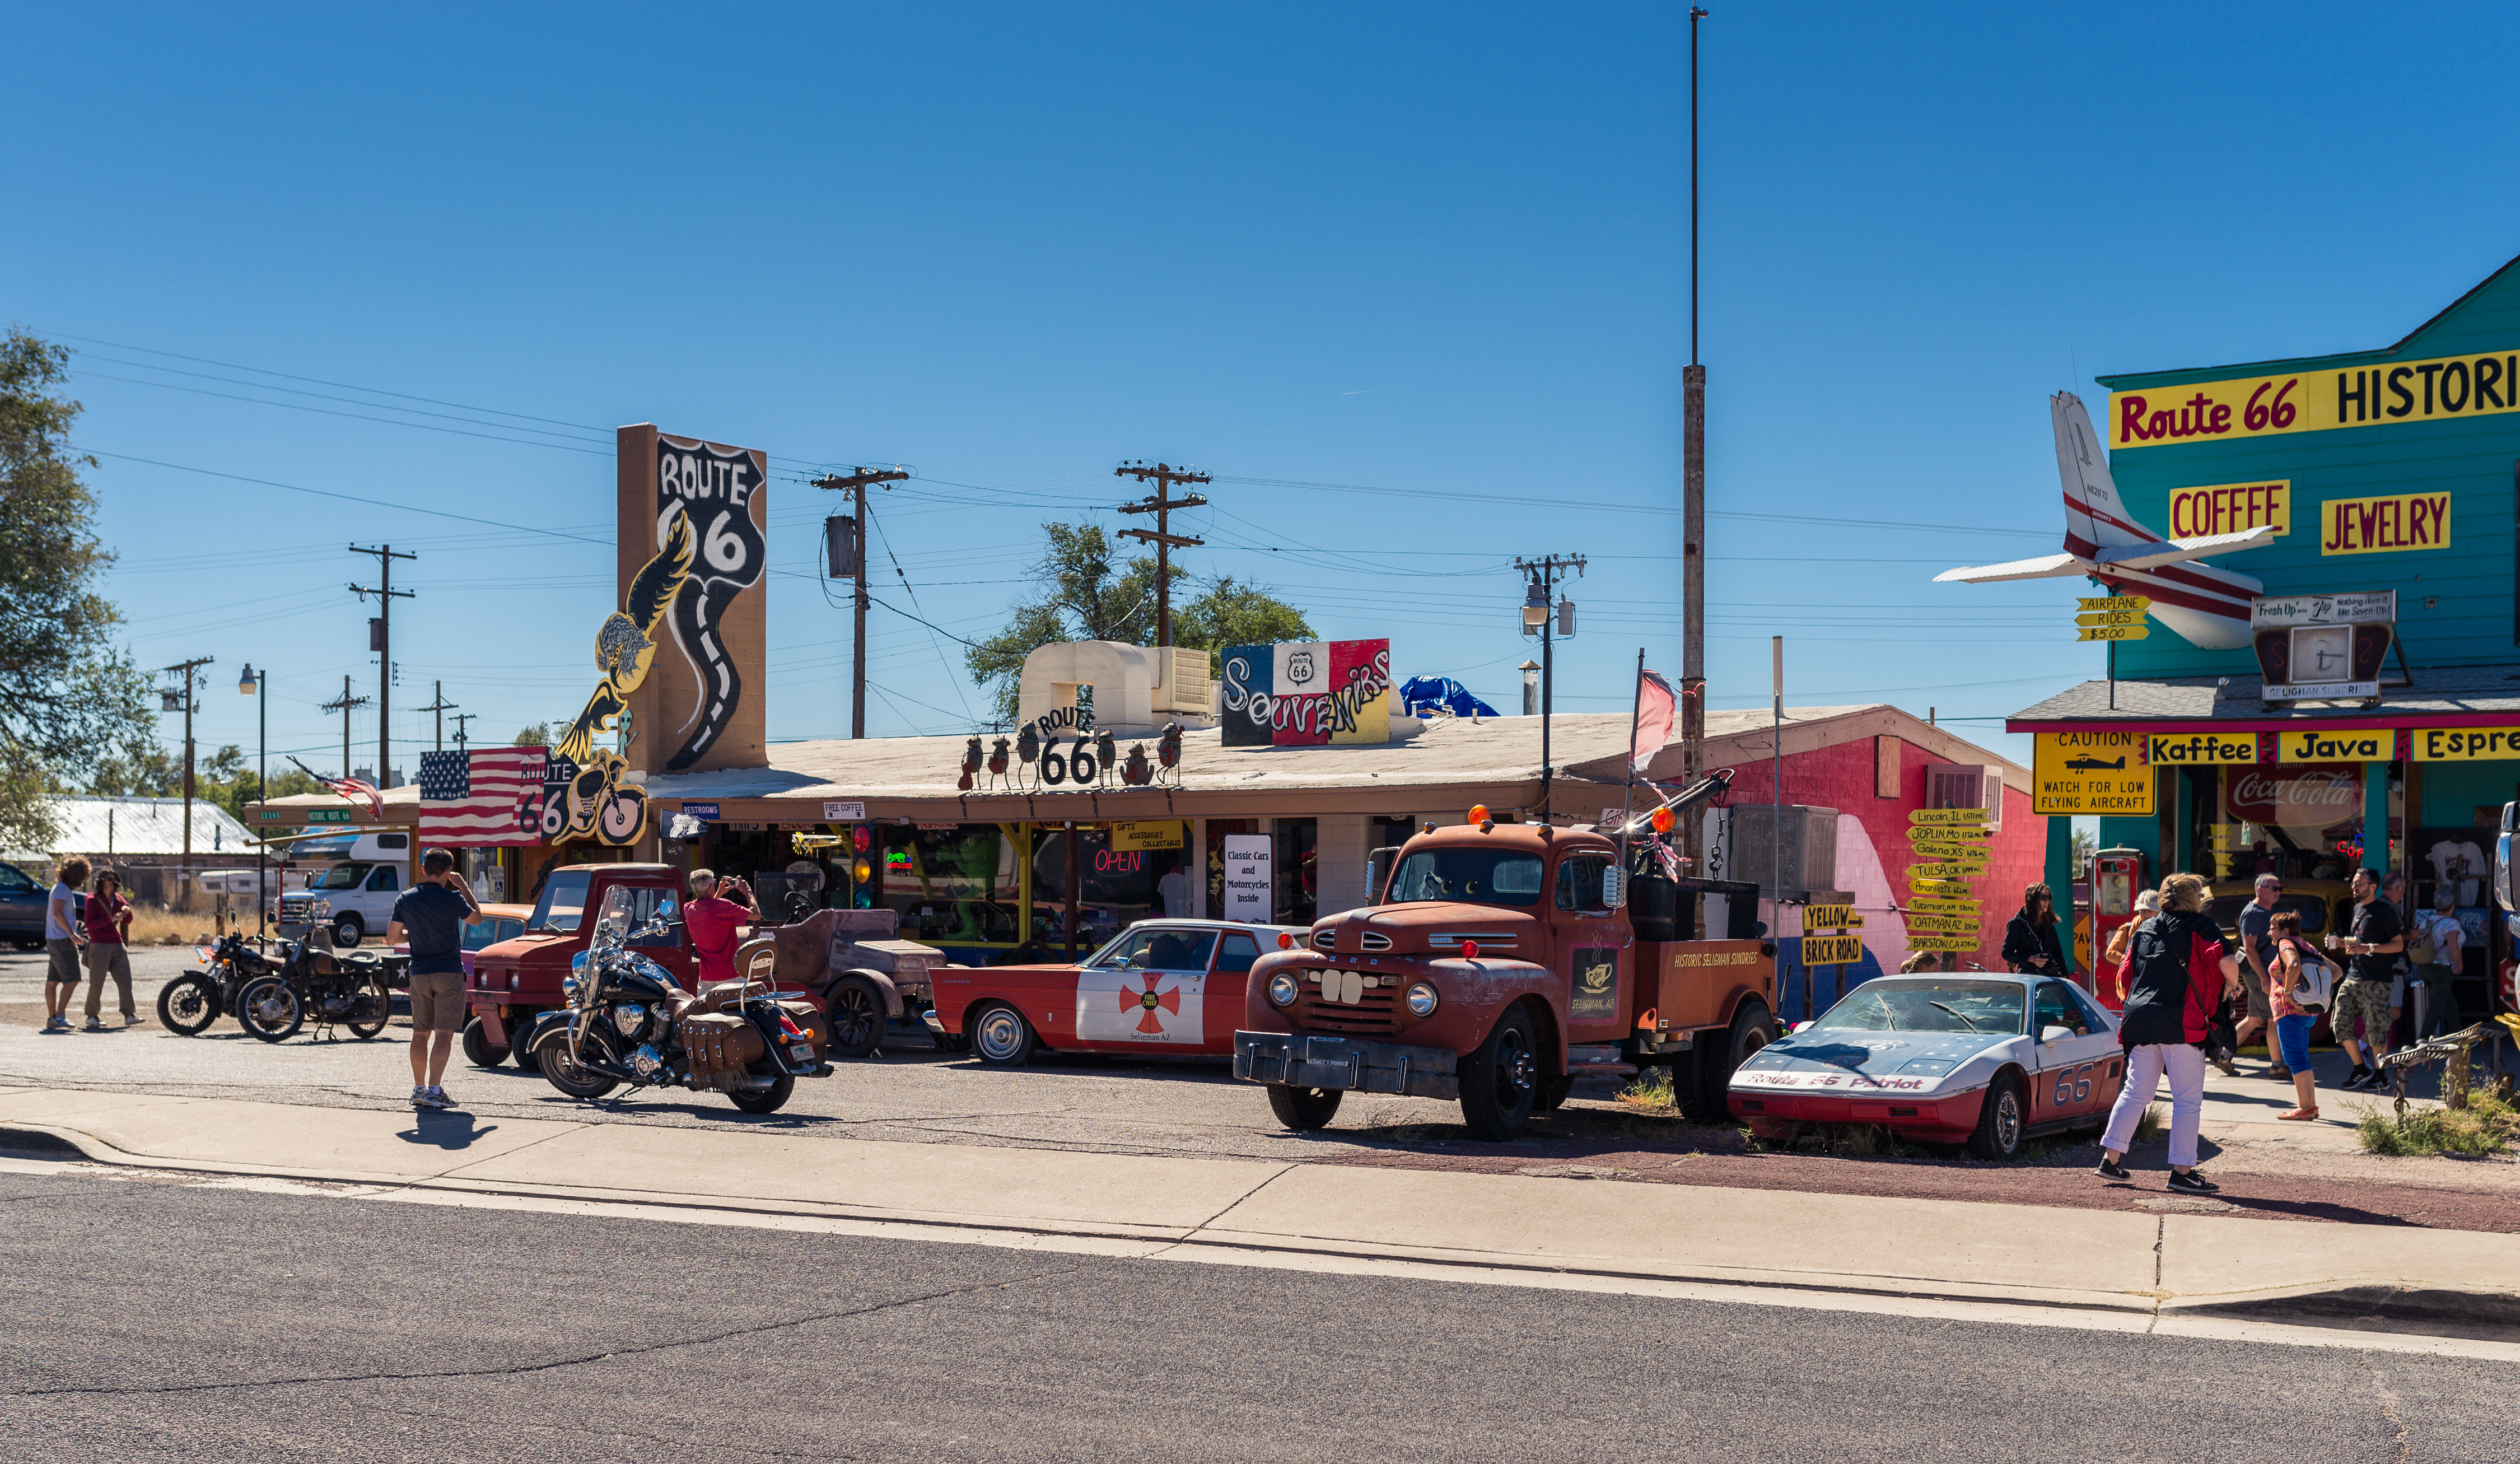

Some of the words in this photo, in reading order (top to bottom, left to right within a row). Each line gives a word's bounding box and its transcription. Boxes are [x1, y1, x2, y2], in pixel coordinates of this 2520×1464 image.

[2120, 393, 2232, 443] Route
[2244, 379, 2298, 431] 66
[2338, 355, 2517, 423] HISTORI
[660, 452, 749, 506] ROUTE
[2087, 483, 2108, 501] N6267D
[2173, 484, 2284, 538] COFFEE
[2325, 496, 2447, 551] JEWELRY
[657, 498, 746, 572] 66
[2087, 597, 2139, 609] AIRPLANE
[2337, 598, 2363, 607] Nothing
[2338, 607, 2350, 616] like
[2352, 604, 2391, 616] Seven-Up!
[2098, 612, 2131, 624] RIDES
[2090, 628, 2125, 640] $5.00
[1293, 665, 1308, 678] 66
[2270, 685, 2318, 697] SELIGMAN
[2322, 684, 2370, 695] SUNDRIES
[1038, 706, 1096, 736] ROUTE
[2059, 732, 2131, 746] CAUTION
[2152, 737, 2251, 761] Kaffee
[2295, 733, 2378, 758] Java
[1041, 736, 1096, 785] 66
[521, 763, 571, 780] ROUTE
[2044, 781, 2080, 793] WATCH
[2089, 781, 2111, 793] FOR
[2120, 781, 2144, 793] LOW
[841, 803, 863, 812] COFFEE
[2042, 796, 2080, 808] FLYING
[2090, 796, 2146, 808] AIRCRAFT
[308, 812, 325, 821] HISTORIC
[519, 791, 561, 834] 66
[1951, 812, 1961, 820] IL
[1947, 829, 1959, 838] MO
[1228, 851, 1252, 860] Classic
[1253, 852, 1269, 860] Cars
[1952, 847, 1963, 856] KS
[1095, 849, 1141, 871] OPEN
[790, 865, 805, 873] Happy
[1242, 865, 1255, 875] and
[1949, 865, 1960, 874] OK
[1227, 880, 1270, 890] Motorcycles
[1237, 894, 1259, 903] Inside
[1808, 906, 1849, 927] YELLOW
[1952, 920, 1962, 930] AZ
[1805, 939, 1834, 963] BRICK
[1837, 938, 1859, 961] ROAD
[1674, 954, 1702, 968] HISTORIC
[1702, 953, 1730, 967] SELIGMAN
[1731, 952, 1758, 966] SUNDRIES
[1589, 971, 1602, 983] Coffee
[1571, 999, 1603, 1009] SELIGMAN,
[1605, 998, 1614, 1008] AZ
[1130, 1033, 1159, 1042] Seligman
[1748, 1074, 1800, 1085] Route
[1808, 1076, 1841, 1085] 66
[1849, 1078, 1925, 1089] Patriot
[2052, 1064, 2093, 1108] 66
